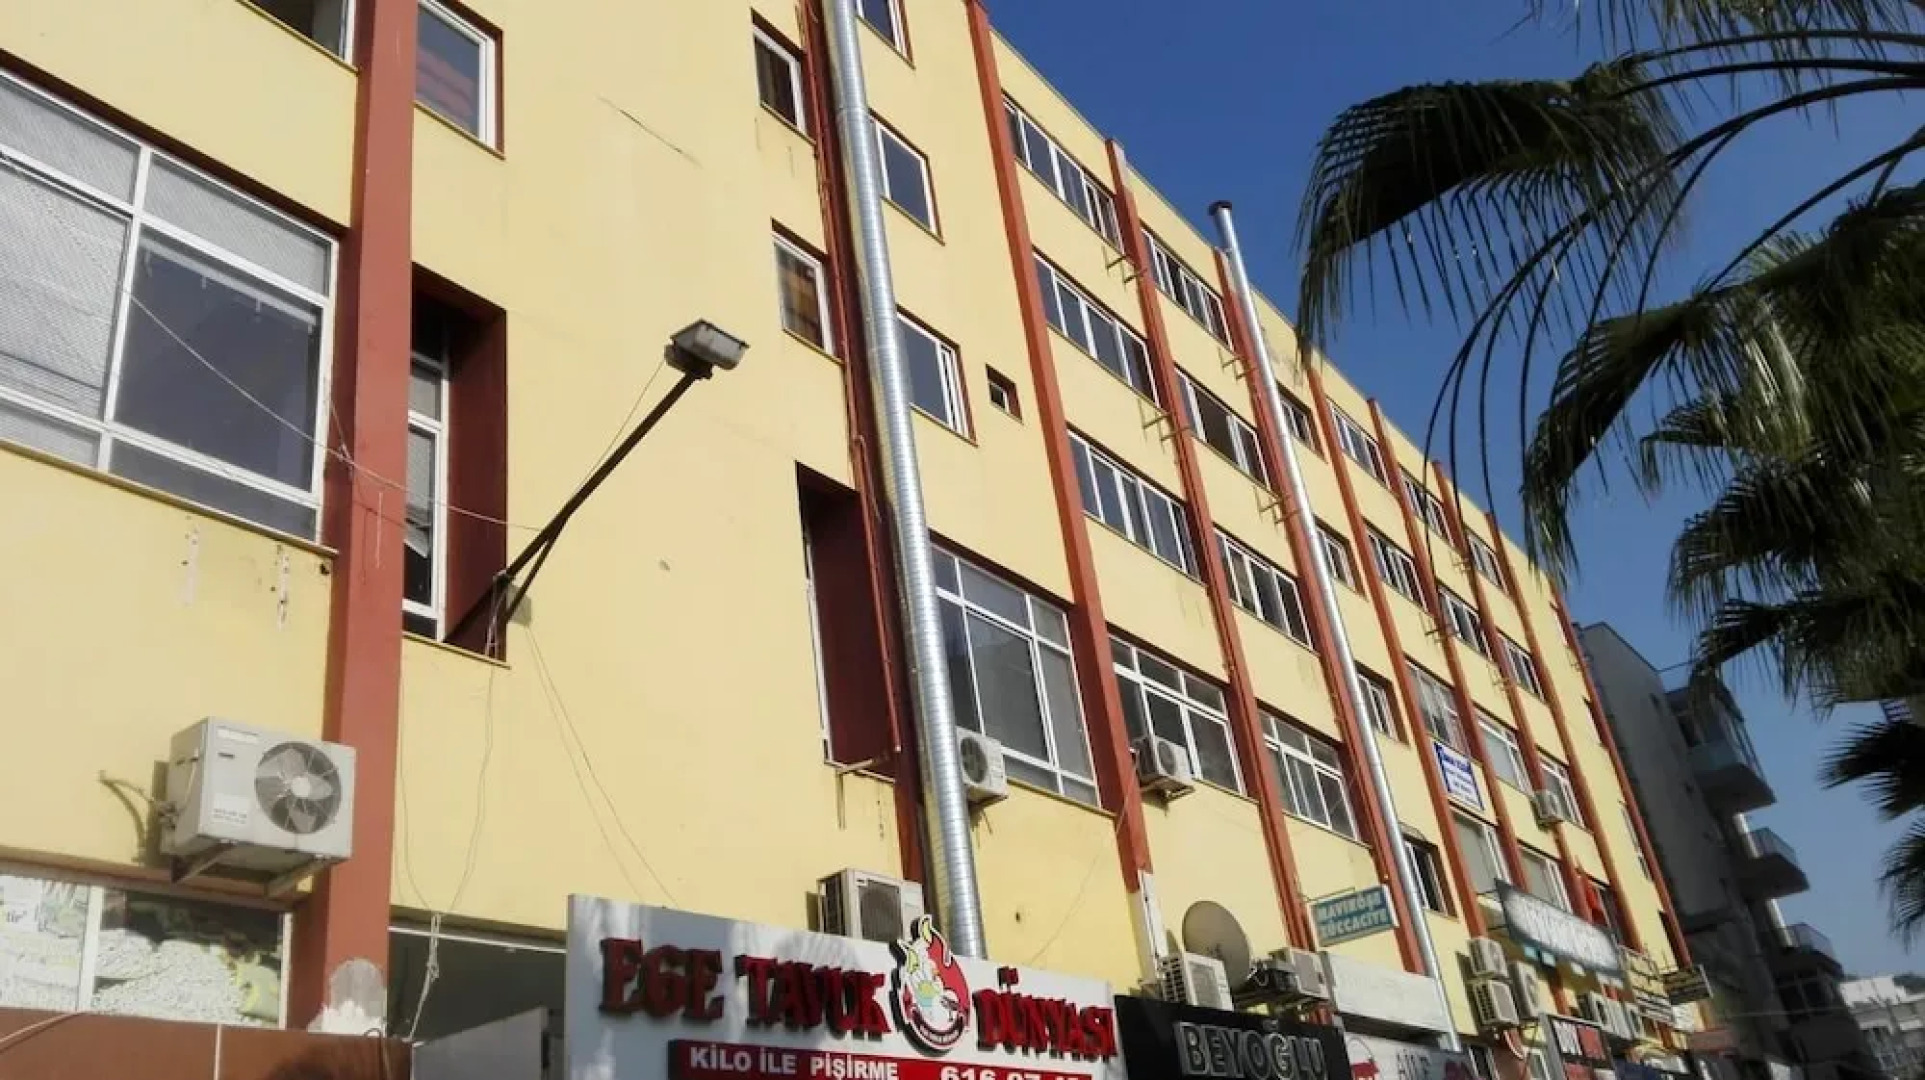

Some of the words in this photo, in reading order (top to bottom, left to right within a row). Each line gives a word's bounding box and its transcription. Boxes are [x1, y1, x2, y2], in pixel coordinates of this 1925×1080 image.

[600, 938, 724, 1019] EGE
[735, 954, 892, 1038] TAVUK
[973, 966, 1119, 1061] DÜNYASI
[690, 1044, 751, 1072] KİLO
[759, 1047, 797, 1074] İLE
[811, 1053, 899, 1080] PİŞİRME
